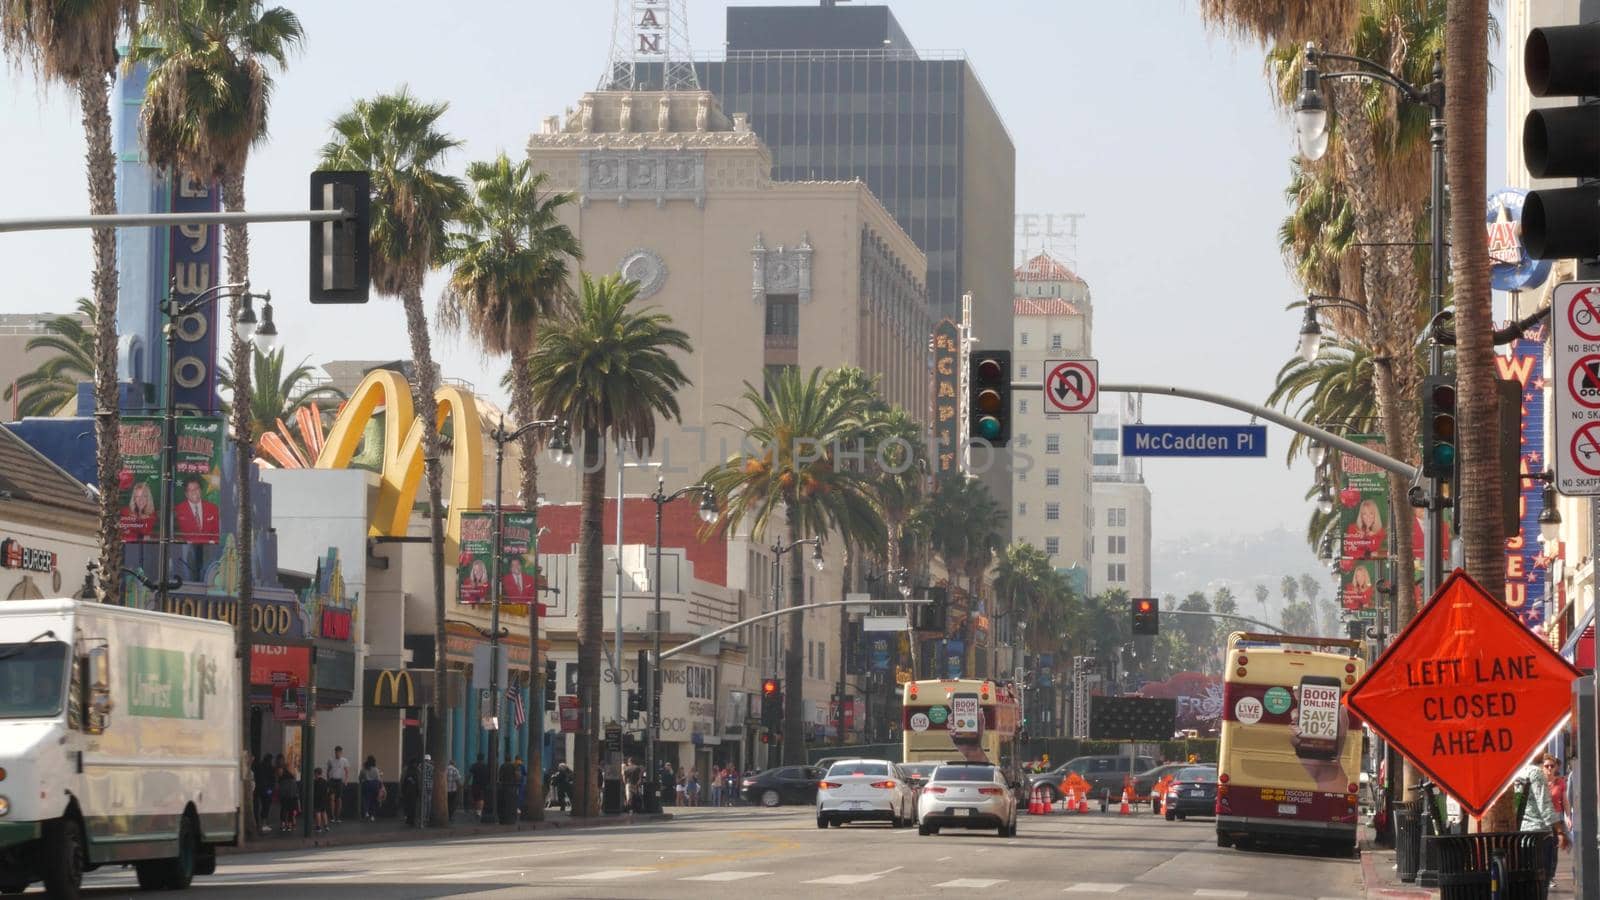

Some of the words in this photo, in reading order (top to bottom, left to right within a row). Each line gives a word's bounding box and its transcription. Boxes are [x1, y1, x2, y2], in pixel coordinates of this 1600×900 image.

[636, 0, 662, 54] AN
[1014, 213, 1086, 237] ELT
[1568, 344, 1580, 353] NO
[1572, 410, 1584, 420] NO
[1587, 410, 1600, 420] SK
[1135, 432, 1228, 450] McCadden
[1236, 433, 1254, 450] Pl
[1562, 479, 1573, 487] NO
[1406, 659, 1461, 687] LEFT
[1475, 655, 1539, 684] LANE
[1303, 689, 1337, 701] BOOK
[1239, 704, 1260, 714] LIVE
[1302, 700, 1336, 709] ONLINE
[1423, 692, 1517, 721] CLOSED
[1302, 710, 1336, 722] SAVE
[1302, 721, 1336, 737] 10%
[1432, 728, 1514, 757] AHEAD
